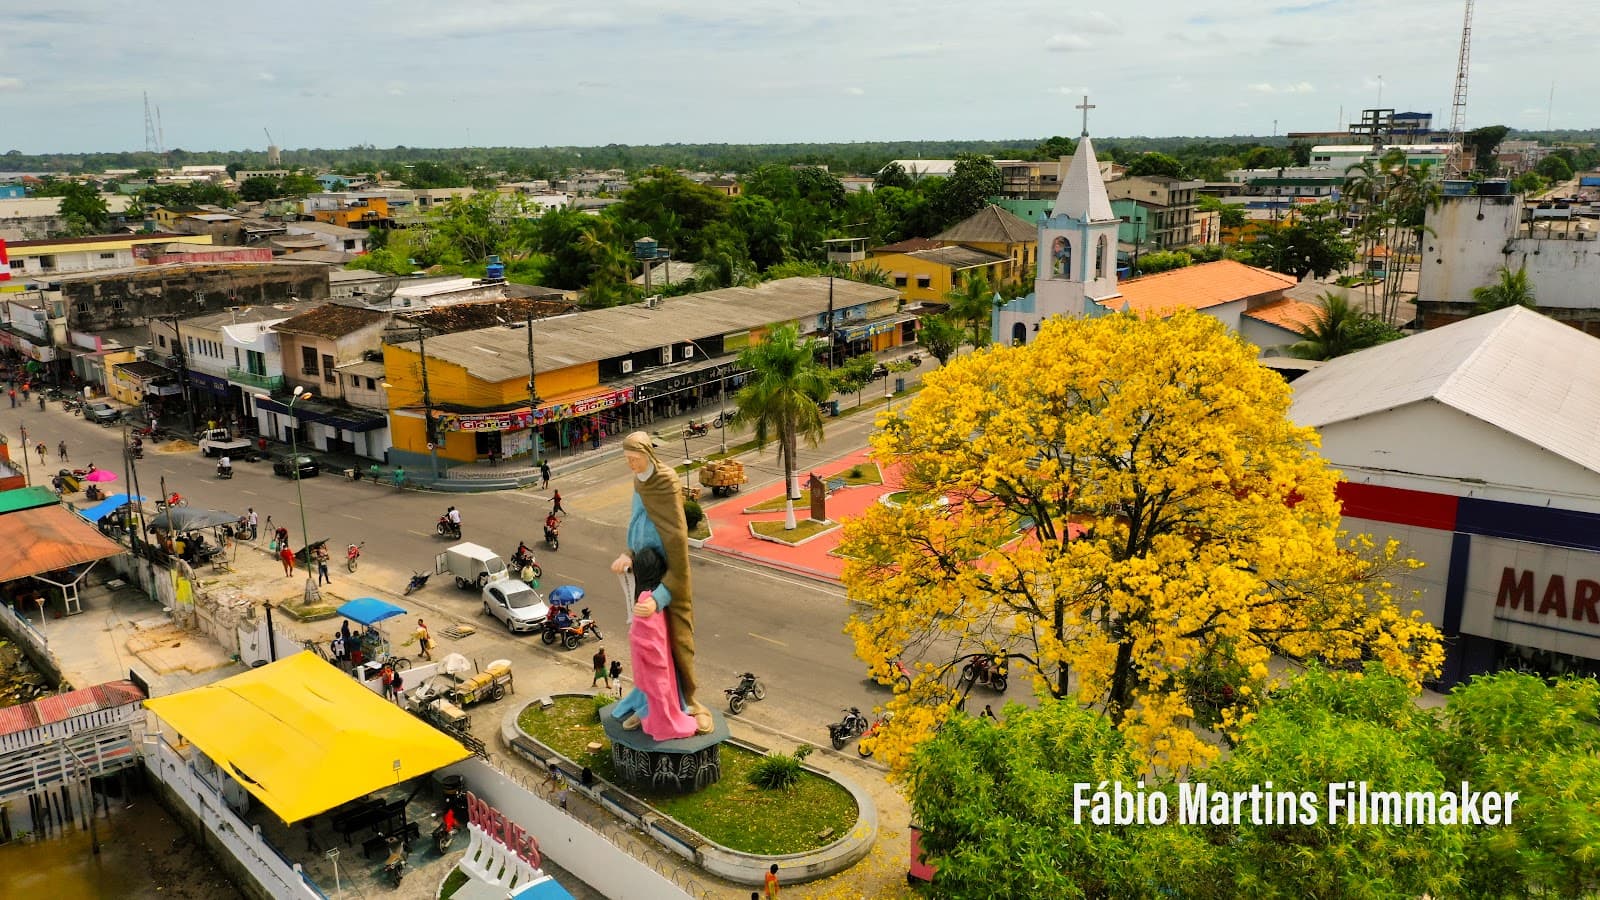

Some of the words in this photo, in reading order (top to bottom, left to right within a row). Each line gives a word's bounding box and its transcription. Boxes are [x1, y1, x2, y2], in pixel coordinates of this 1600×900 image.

[667, 375, 694, 389] LOJA
[1496, 566, 1600, 624] MAR
[466, 790, 542, 871] BREVES
